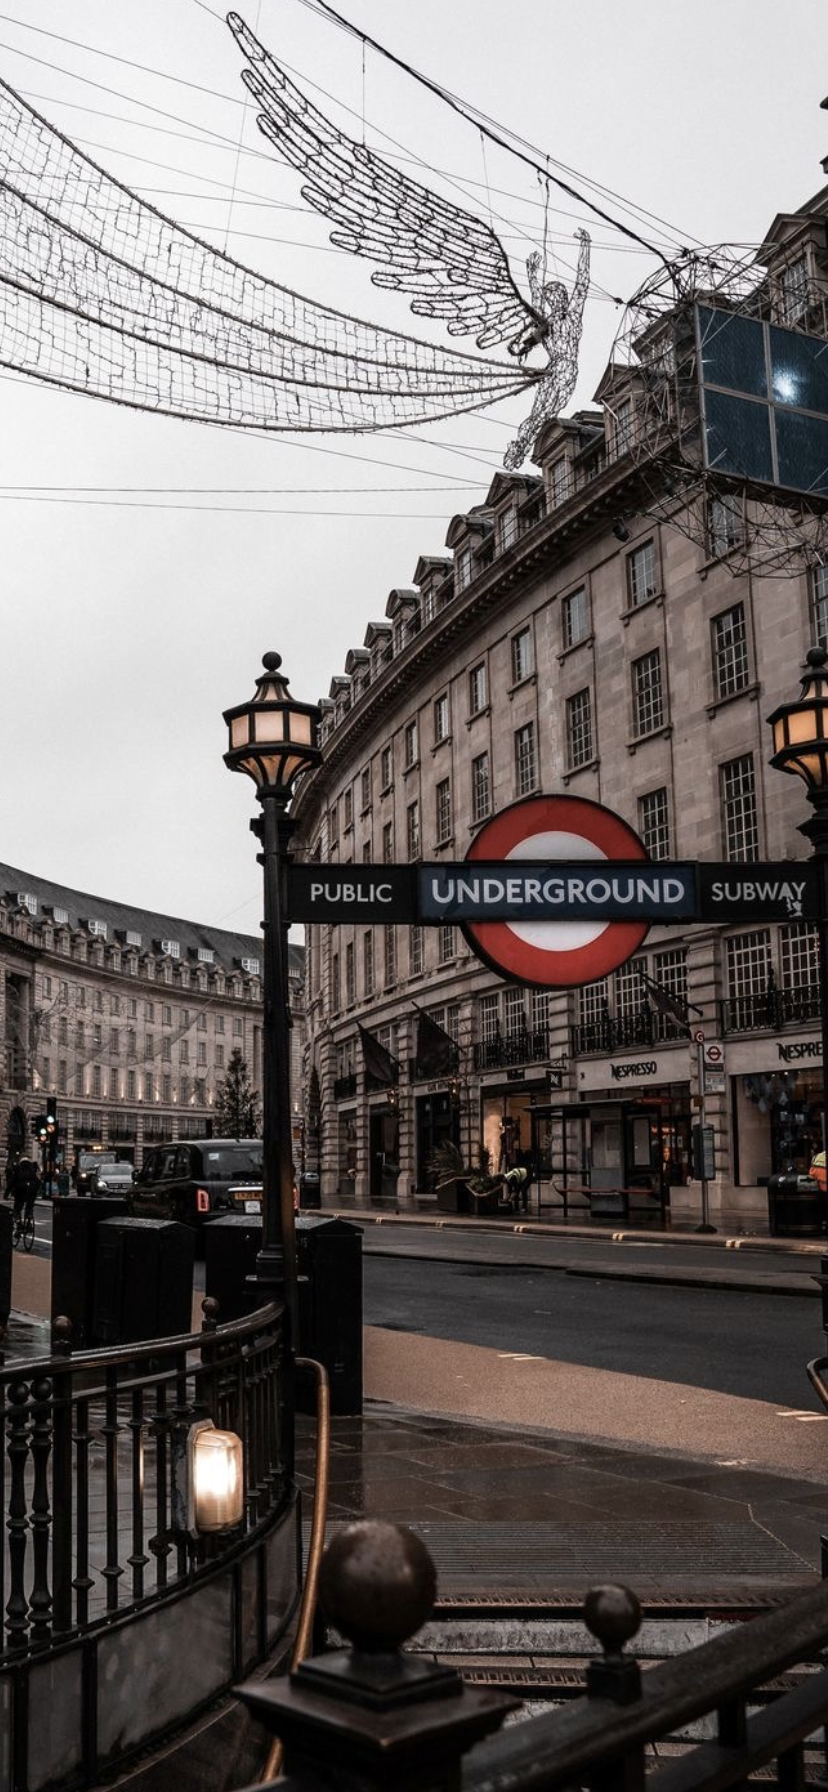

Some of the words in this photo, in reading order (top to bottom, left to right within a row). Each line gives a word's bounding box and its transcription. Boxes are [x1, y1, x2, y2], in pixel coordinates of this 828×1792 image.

[311, 883, 393, 903] PUBLIC
[432, 878, 685, 904] UNDERGROUND
[711, 881, 806, 902] SUBWAY
[610, 1061, 657, 1081] NESPRESSO
